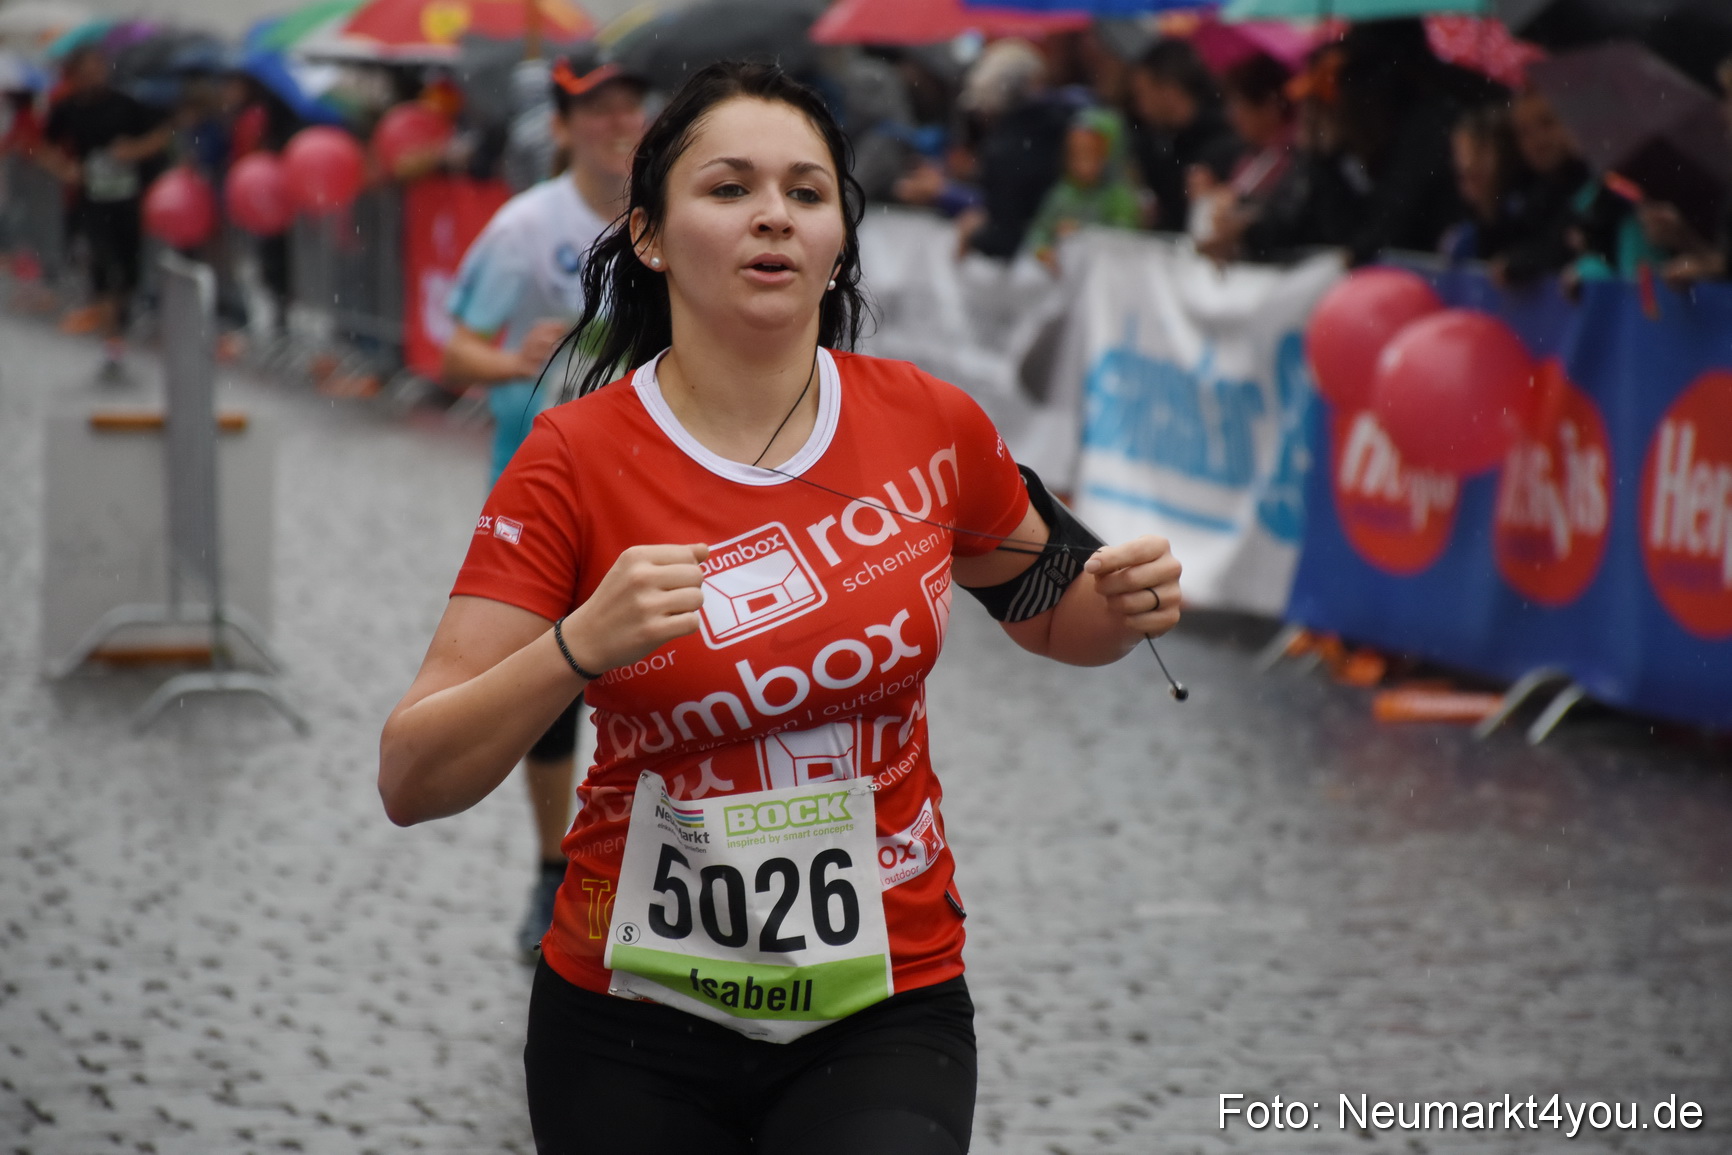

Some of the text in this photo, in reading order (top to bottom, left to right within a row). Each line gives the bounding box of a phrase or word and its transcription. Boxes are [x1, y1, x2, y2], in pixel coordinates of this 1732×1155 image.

[1652, 416, 1732, 588] Her
[698, 533, 785, 576] aumbox
[842, 532, 940, 592] schenken
[600, 608, 921, 759] aumbox
[822, 667, 923, 717] outdoor
[723, 790, 853, 838] BOCK
[727, 822, 855, 849] inspired by smart concepts
[878, 840, 917, 870] ox
[884, 865, 920, 886] outdoor
[648, 842, 860, 953] 5026
[622, 925, 634, 942] S
[689, 967, 813, 1012] Isabell
